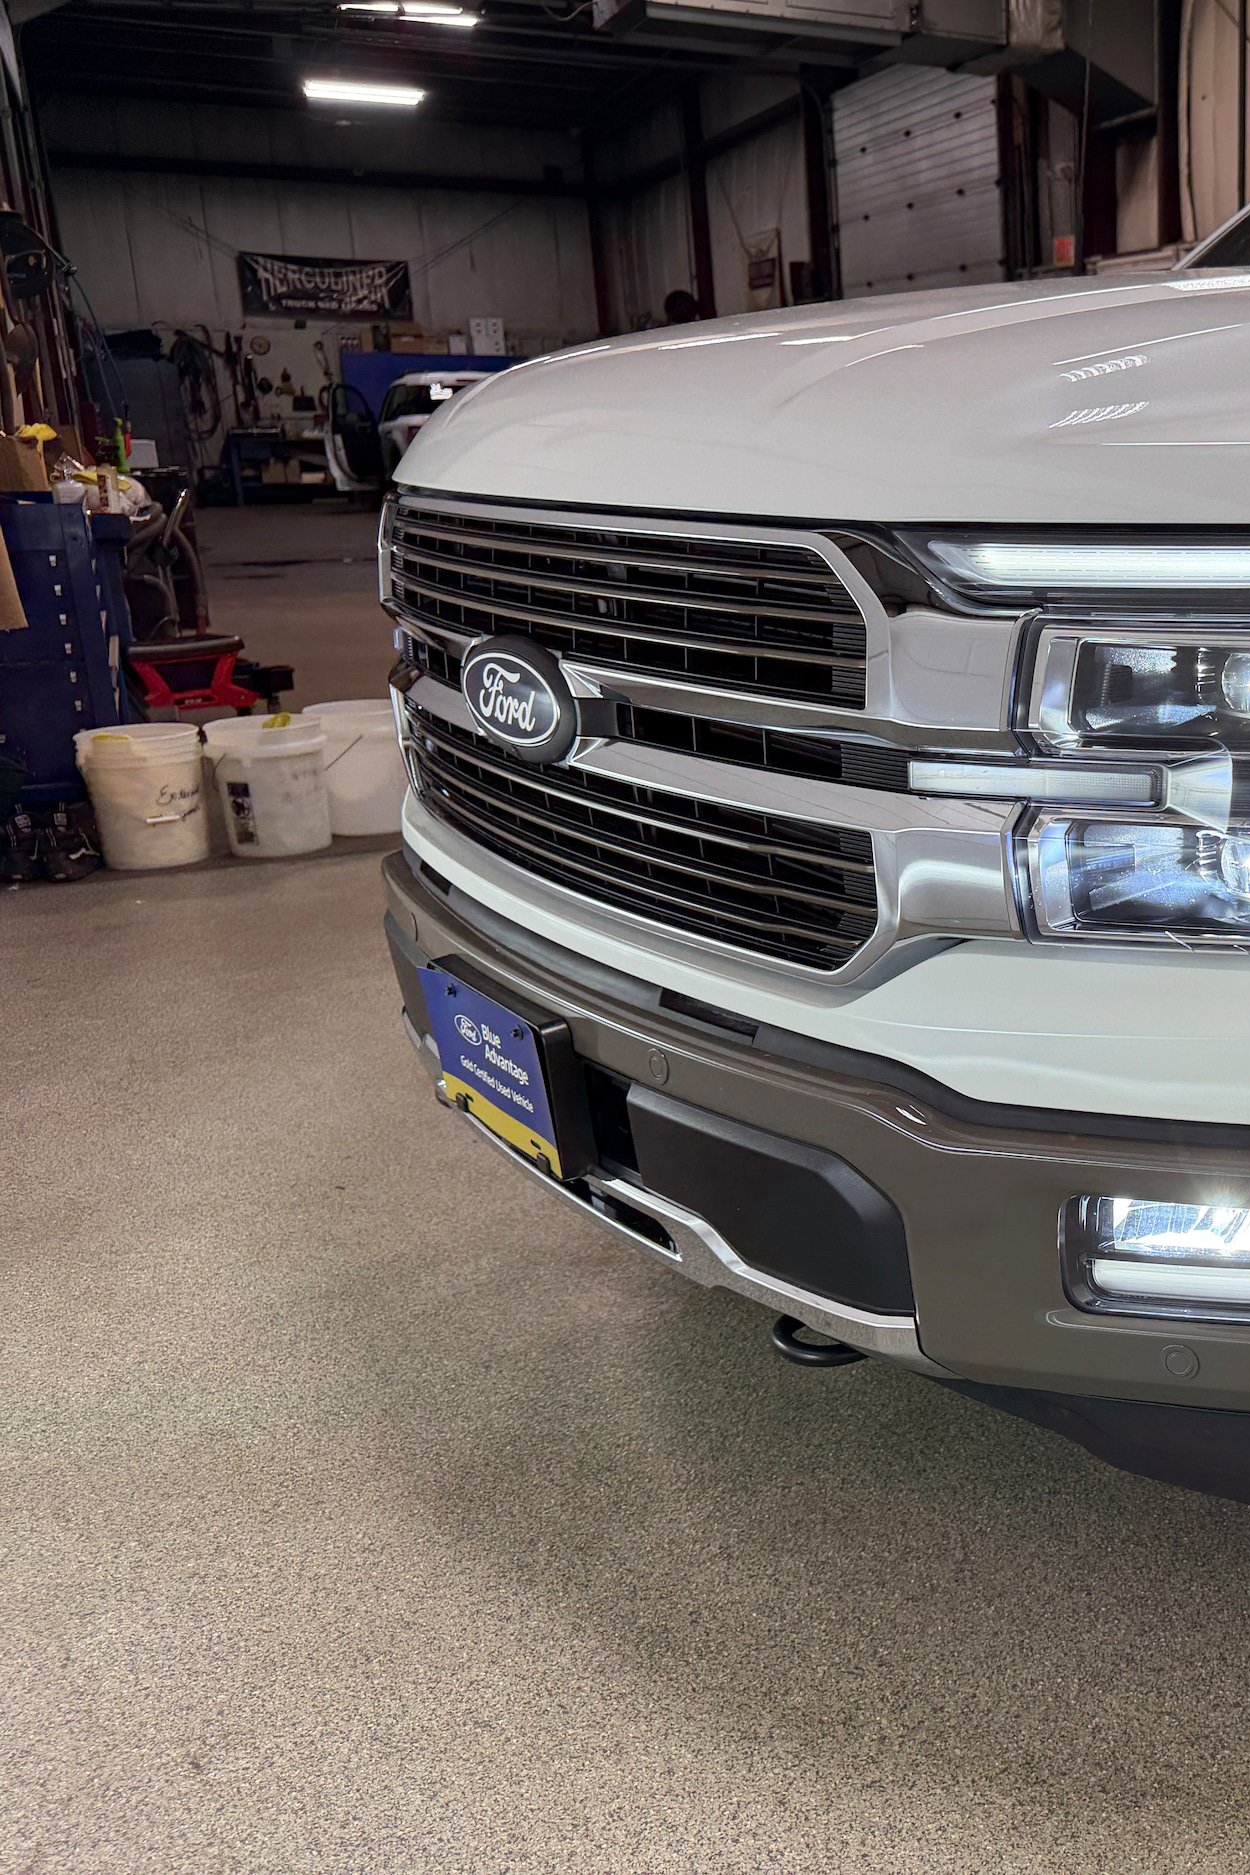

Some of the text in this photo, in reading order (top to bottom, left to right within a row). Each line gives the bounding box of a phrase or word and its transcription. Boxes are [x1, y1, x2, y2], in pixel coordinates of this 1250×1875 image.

[480, 662, 536, 732] Ford
[460, 1017, 478, 1042] Ford
[481, 1024, 501, 1049] Blue
[460, 1055, 534, 1114] Gold Certified Used Vehicle
[485, 1044, 530, 1086] Advantage
